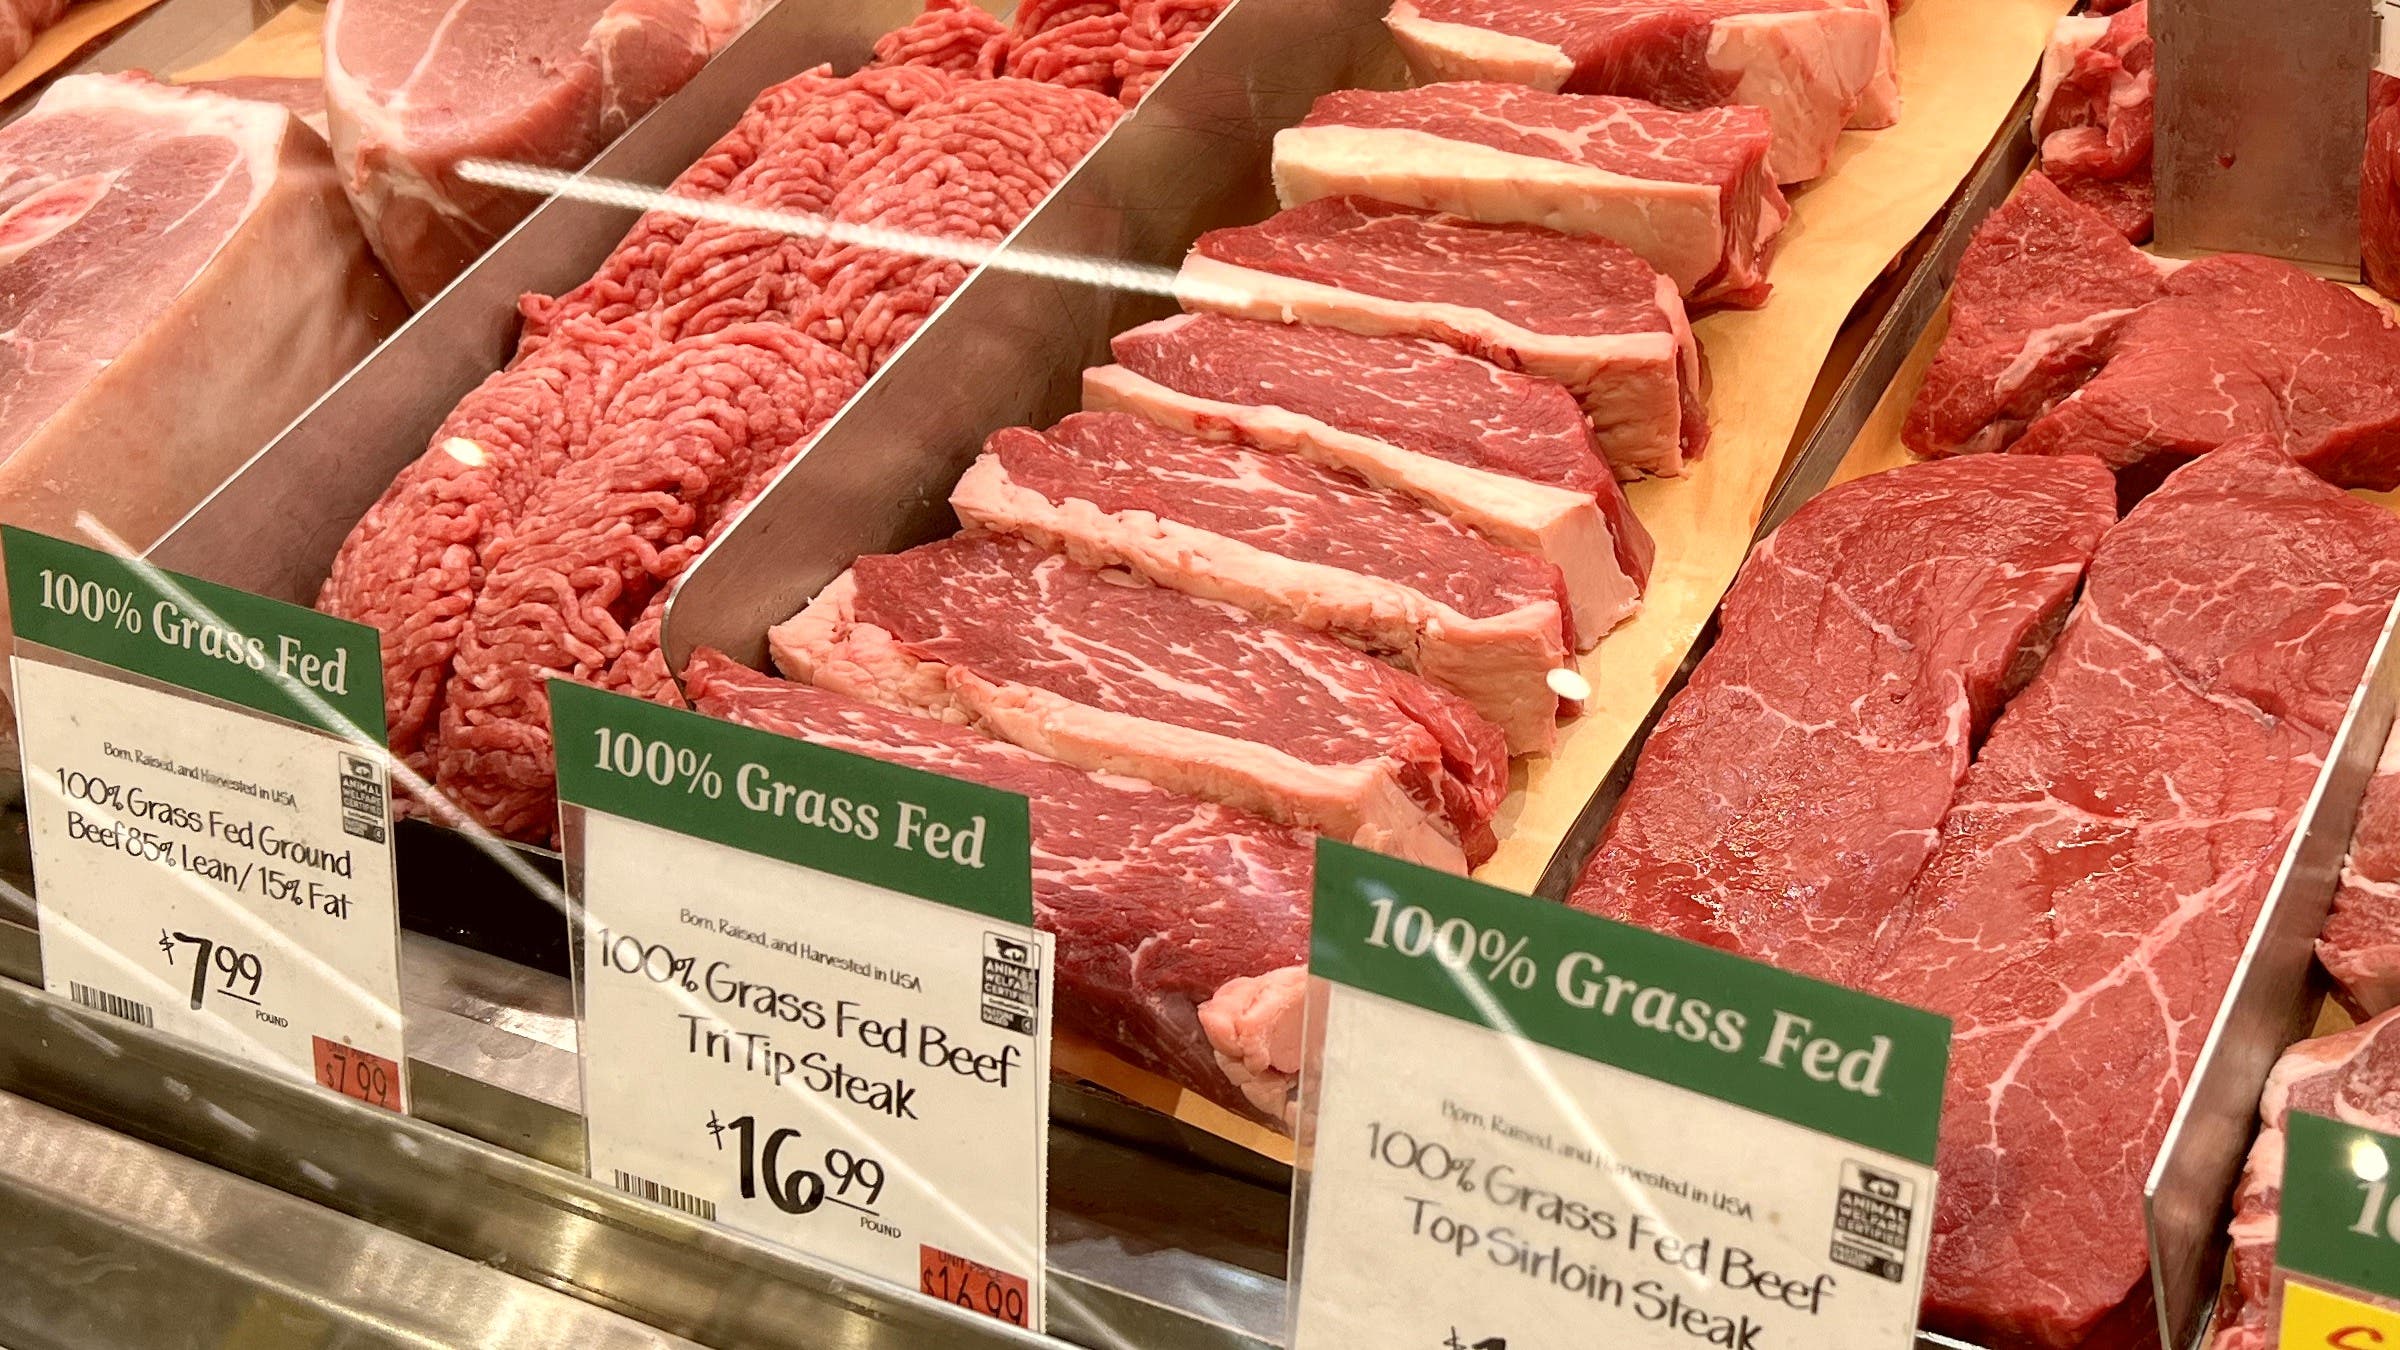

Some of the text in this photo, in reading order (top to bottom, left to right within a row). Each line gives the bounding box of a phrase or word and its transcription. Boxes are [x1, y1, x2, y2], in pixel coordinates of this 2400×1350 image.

[39, 569, 348, 695] 100% Grass Fed
[56, 767, 352, 879] 100% Grass Fed Ground
[178, 765, 198, 779] and
[200, 768, 257, 797] Harvested
[259, 787, 269, 801] in
[272, 790, 297, 809] USA
[594, 727, 986, 869] 100% Grass Fed
[67, 811, 126, 848] Beef
[126, 826, 177, 866] 85%
[258, 866, 303, 906] 15%
[309, 883, 353, 920] Fat
[594, 927, 1021, 1089] 100% Grass Fed Beef
[719, 918, 769, 949] Raised,
[771, 938, 798, 957] and
[800, 943, 871, 977] Harvested
[875, 966, 886, 982] in
[890, 968, 922, 993] USA
[1363, 896, 1891, 1098] 100% Grass Fed
[255, 1008, 289, 1029] POUND
[679, 1013, 919, 1121] Tri Tip Steak
[859, 1216, 902, 1239] POUND
[1366, 1120, 1836, 1315] 100% Grass Fed Beef
[1691, 1183, 1708, 1203] in
[1712, 1191, 1753, 1222] USA
[1403, 1195, 1763, 1350] Top Sirloin Steak
